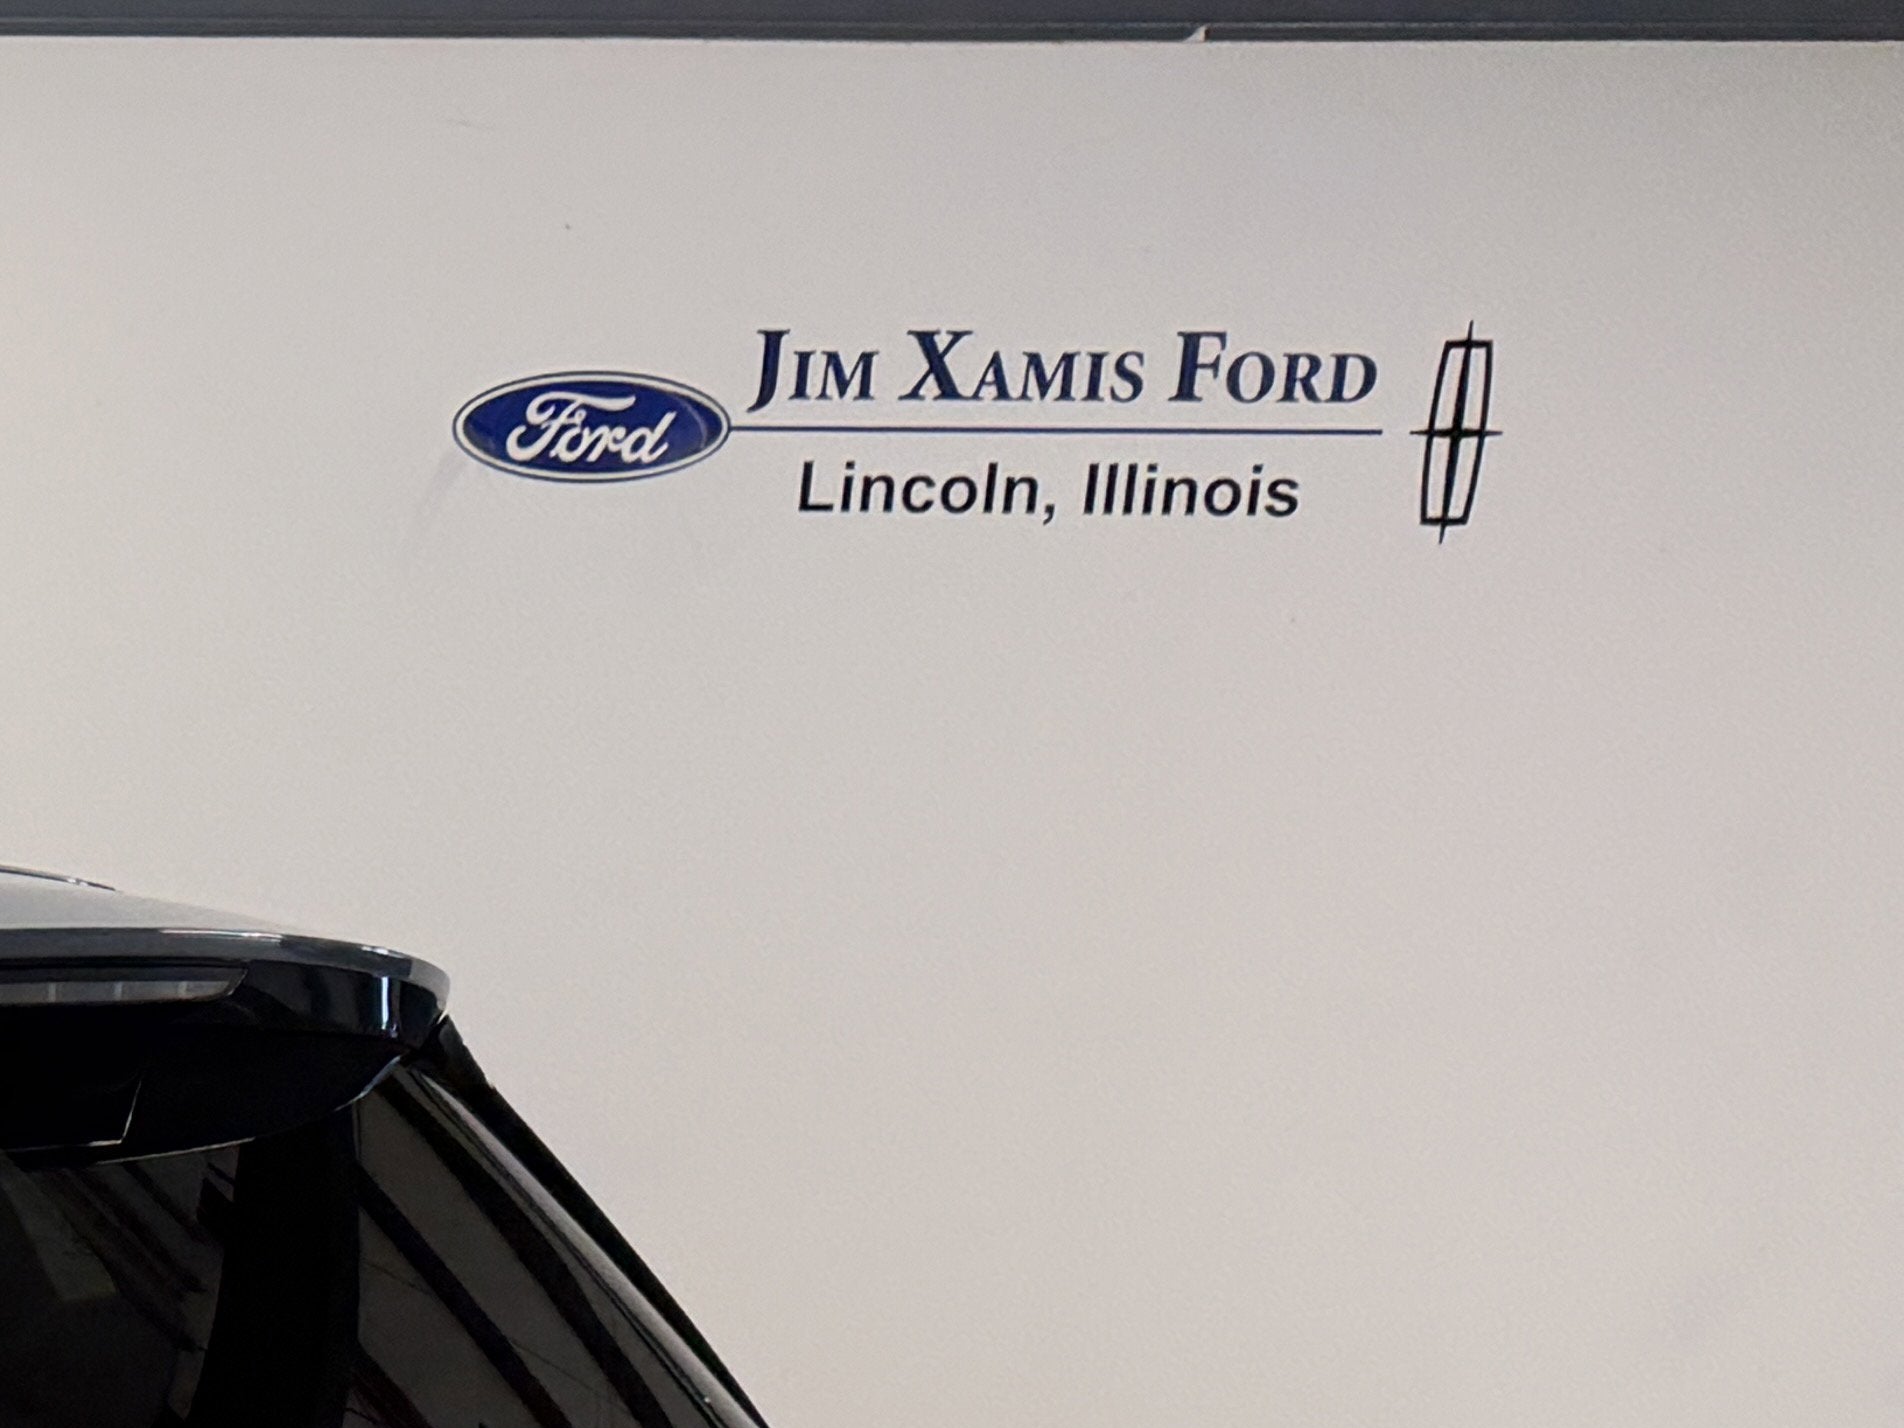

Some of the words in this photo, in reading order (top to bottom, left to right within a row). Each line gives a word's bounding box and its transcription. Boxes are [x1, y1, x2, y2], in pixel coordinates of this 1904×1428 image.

[746, 328, 880, 413] JIM
[901, 329, 1145, 404] XAMIS
[1168, 331, 1378, 405] FORD
[505, 390, 676, 467] Ford
[797, 460, 1056, 524] Lincoln,
[1082, 461, 1300, 518] Illinois
